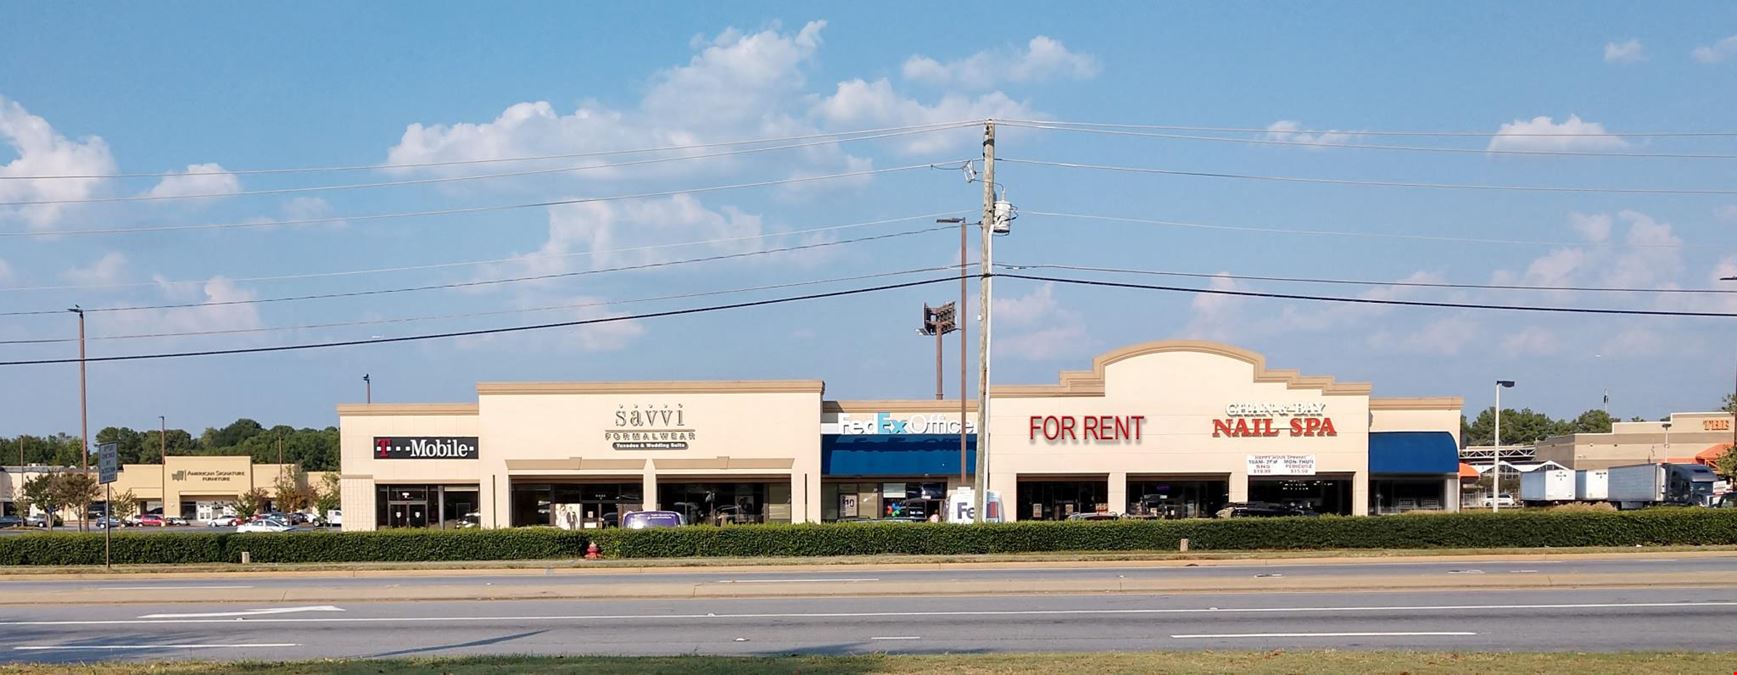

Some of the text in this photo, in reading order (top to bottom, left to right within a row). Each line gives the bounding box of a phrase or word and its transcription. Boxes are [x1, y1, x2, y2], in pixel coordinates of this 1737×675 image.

[615, 403, 685, 427] savvi
[1294, 402, 1327, 417] BAY
[838, 412, 908, 434] FedEx
[1029, 415, 1145, 441] FOR RENT
[1212, 417, 1337, 437] NAIL SPA
[605, 432, 696, 441] FORMALWEAR
